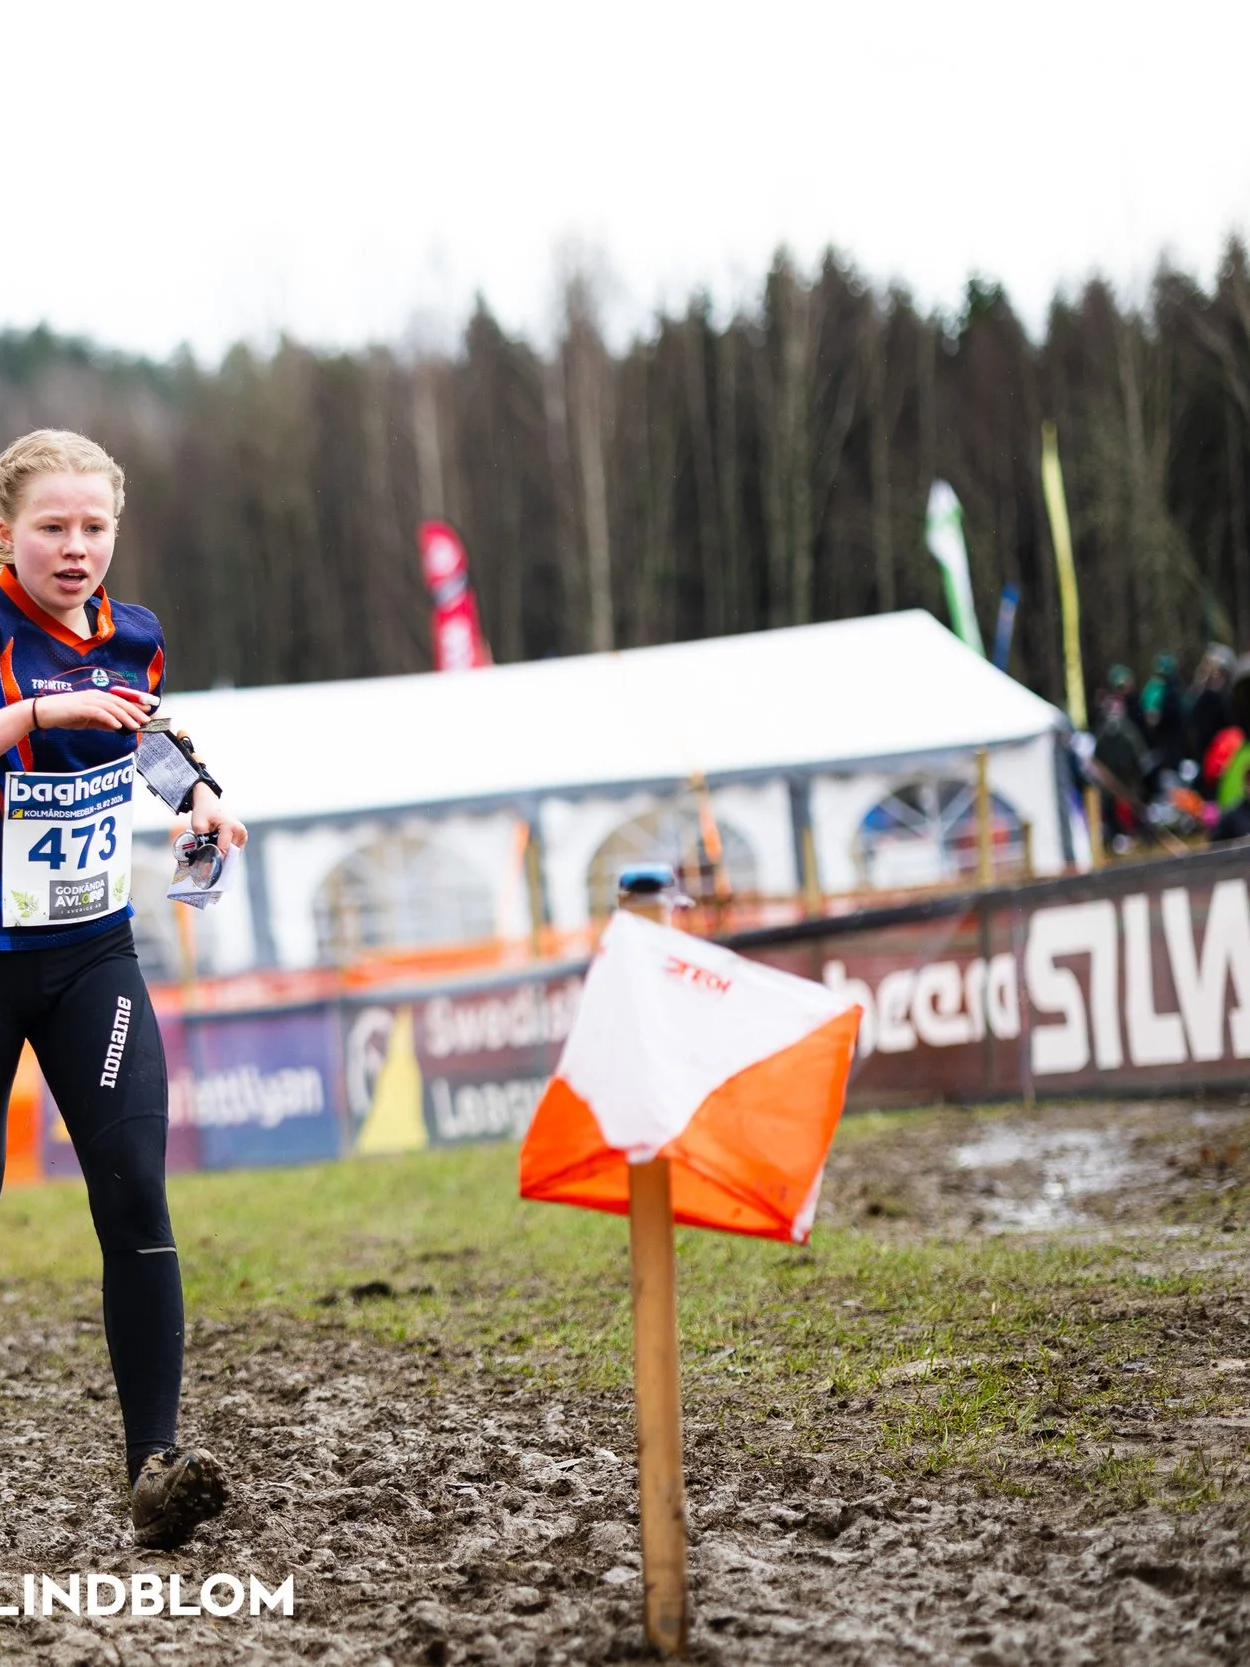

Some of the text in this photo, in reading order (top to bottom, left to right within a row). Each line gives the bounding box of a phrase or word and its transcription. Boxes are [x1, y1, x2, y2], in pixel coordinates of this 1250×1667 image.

[10, 765, 134, 806] bagheera
[28, 816, 116, 870] 473
[55, 879, 105, 895] GODKÄNDA
[99, 996, 132, 1089] noname
